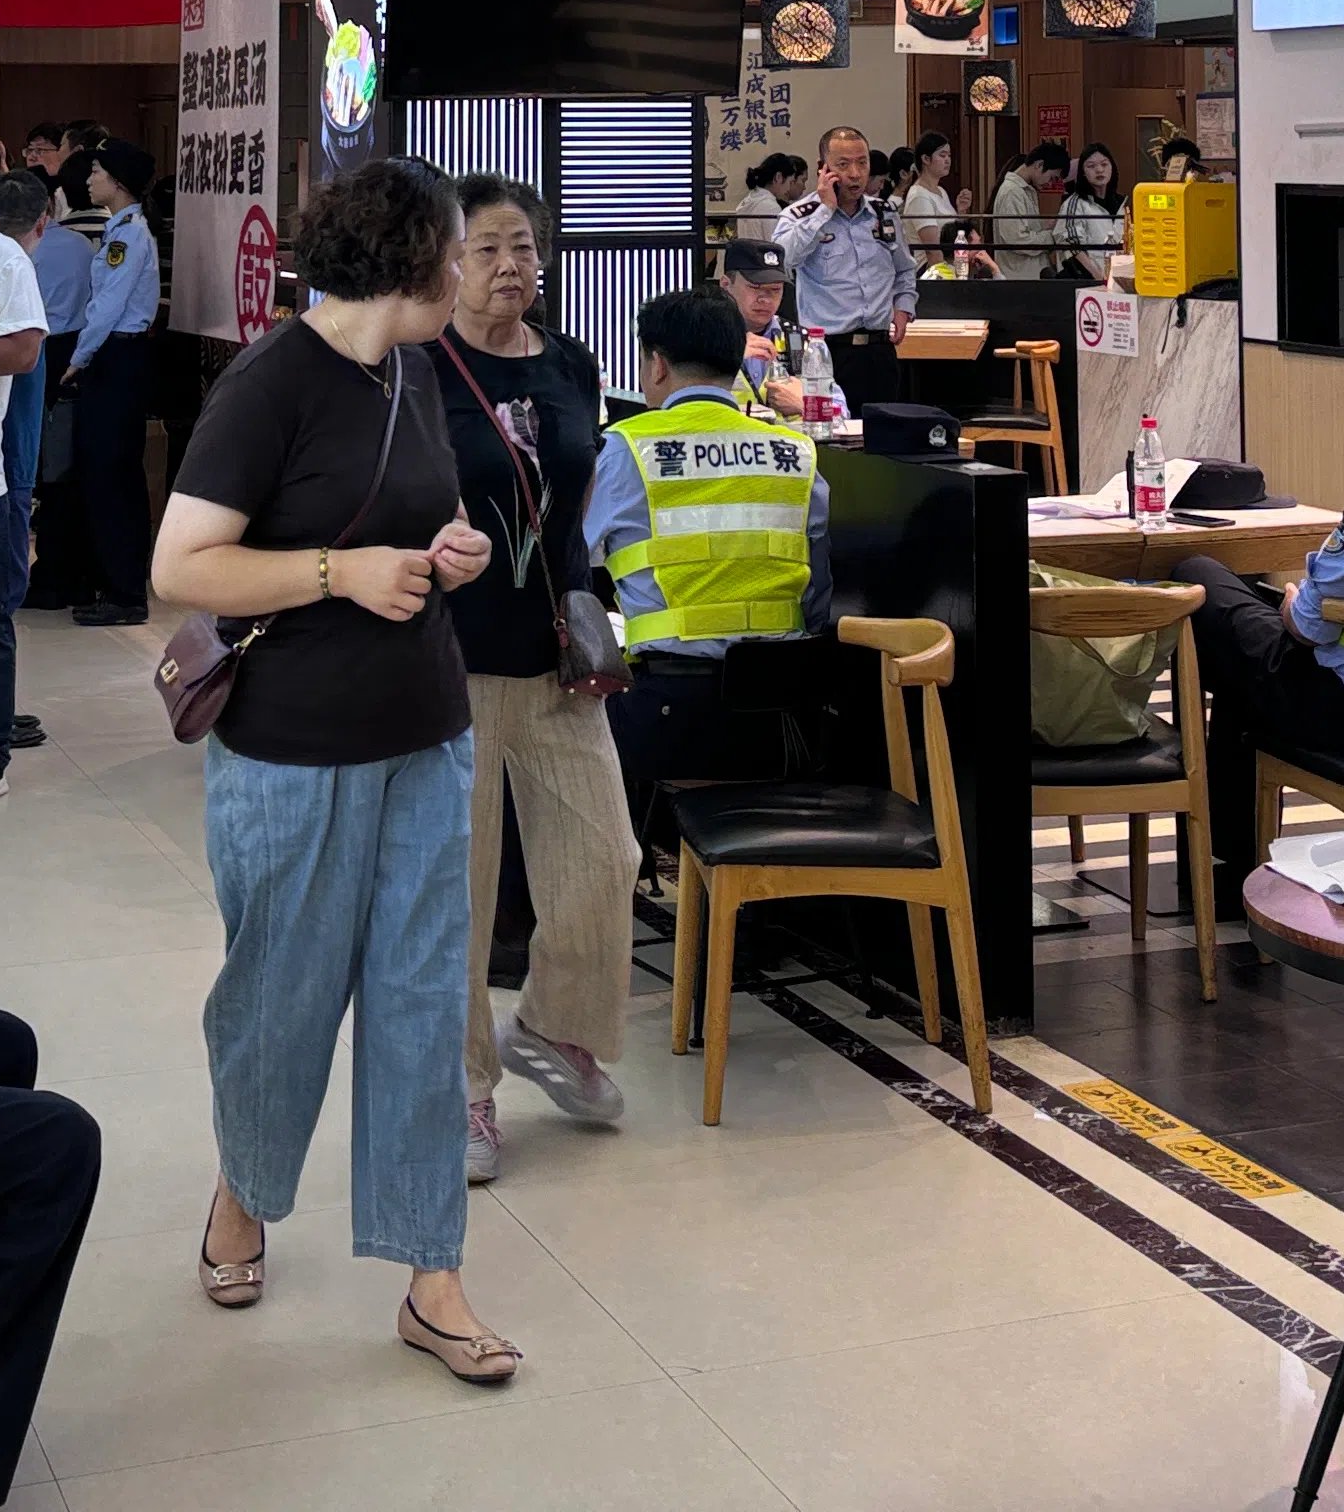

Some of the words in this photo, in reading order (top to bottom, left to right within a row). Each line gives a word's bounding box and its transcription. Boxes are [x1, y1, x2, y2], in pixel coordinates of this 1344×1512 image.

[181, 38, 268, 113] 整鸡熬原汤
[178, 127, 265, 196] 汤浓粉更香
[654, 440, 688, 478] 警
[694, 442, 768, 468] POLICE
[770, 439, 802, 473] 察
